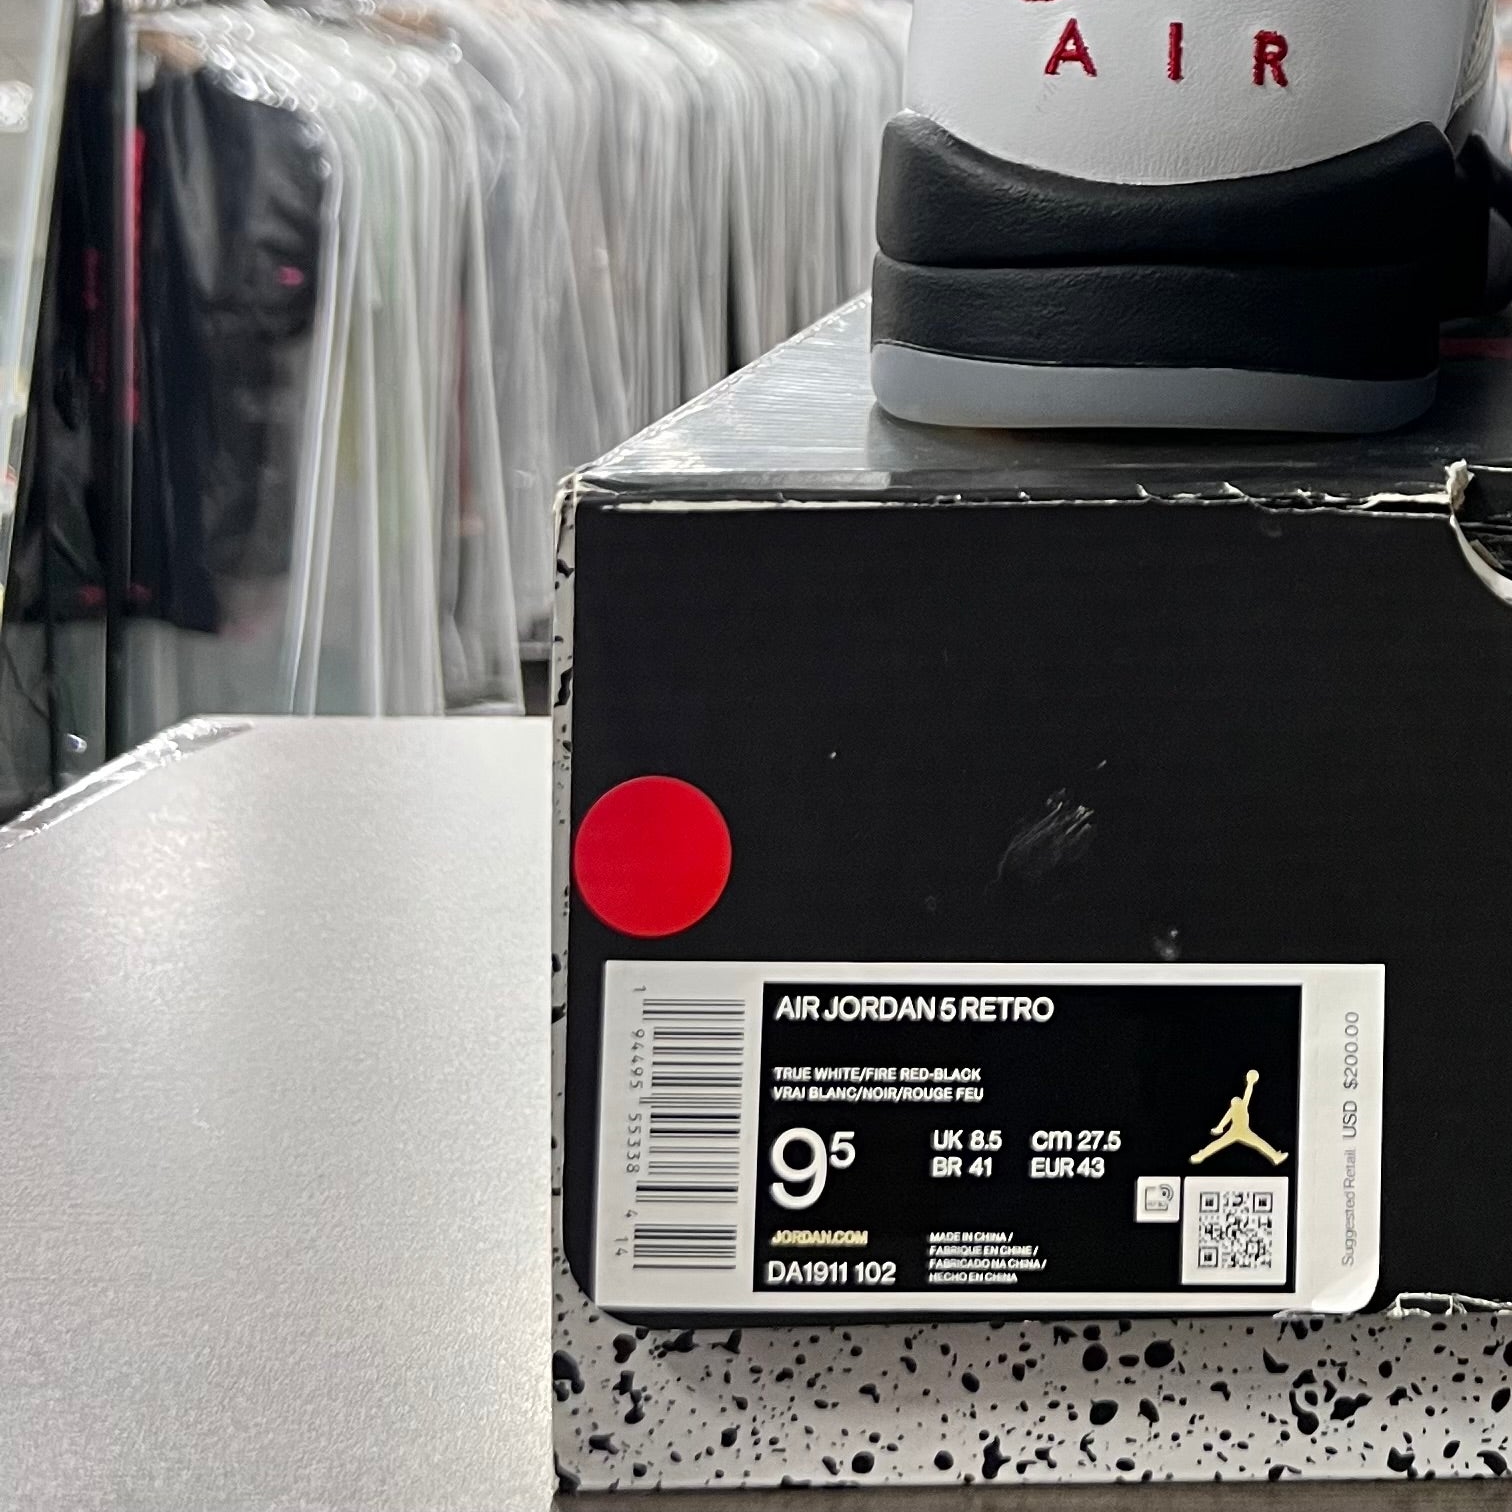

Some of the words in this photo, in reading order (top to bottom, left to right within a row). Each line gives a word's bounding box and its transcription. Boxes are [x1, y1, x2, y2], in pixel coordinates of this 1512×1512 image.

[1044, 18, 1288, 87] AIR
[775, 995, 820, 1021] AIR
[822, 995, 936, 1022] JORDAN
[939, 996, 957, 1022] 5
[960, 996, 1055, 1022] RETRO
[629, 1028, 645, 1089] 94495
[1343, 1011, 1360, 1090] $200.00
[774, 1067, 811, 1081] TRUE
[814, 1067, 897, 1082] WHITE/FIRE
[900, 1067, 981, 1082] RED-BLACK
[773, 1087, 806, 1101] VRAI
[809, 1087, 952, 1102] BLANC/NOIR/ROUGE
[956, 1088, 984, 1102] FEU
[1342, 1100, 1358, 1139] USD
[626, 1113, 642, 1173] 55338
[933, 1129, 963, 1150] UK
[969, 1129, 1002, 1151] 8.5
[1077, 1130, 1121, 1152] 27.5
[932, 1156, 962, 1178] BR
[968, 1156, 992, 1178] 41
[1030, 1157, 1074, 1178] EUR
[1076, 1157, 1105, 1178] 43
[1343, 1149, 1356, 1189] Retail
[771, 1230, 868, 1247] JORDAN.COM
[929, 1231, 961, 1243] MADE
[962, 1231, 973, 1243] IN
[974, 1231, 1007, 1243] CHINA
[1342, 1190, 1357, 1267] Suggested
[983, 1245, 999, 1257] EN
[767, 1261, 848, 1285] DA1911
[855, 1261, 897, 1285] 102
[991, 1258, 1007, 1271] NA
[1007, 1258, 1041, 1271] CHINA
[929, 1271, 968, 1284] HECHO
[968, 1271, 984, 1284] EN
[984, 1271, 1018, 1284] CHINA
